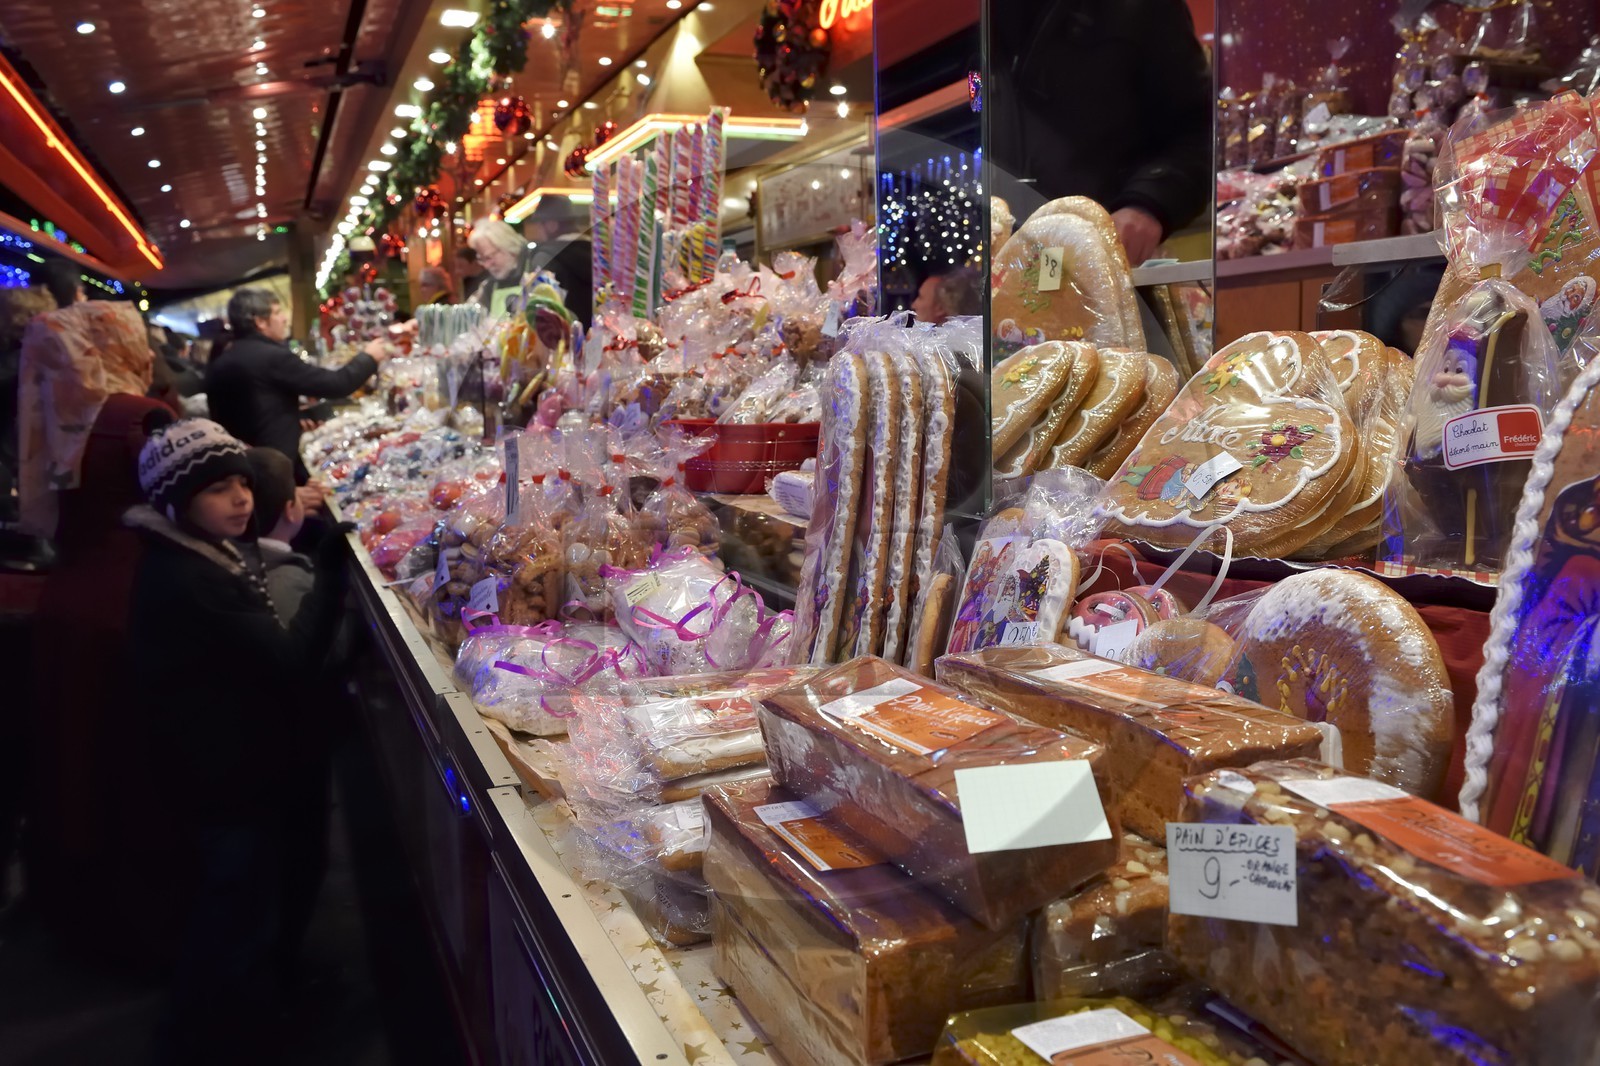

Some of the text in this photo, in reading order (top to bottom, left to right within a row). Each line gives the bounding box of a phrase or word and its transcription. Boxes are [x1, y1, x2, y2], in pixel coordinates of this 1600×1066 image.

[1452, 420, 1488, 438] Chocolat
[1503, 434, 1537, 443] Frédéric
[1471, 441, 1500, 451] main
